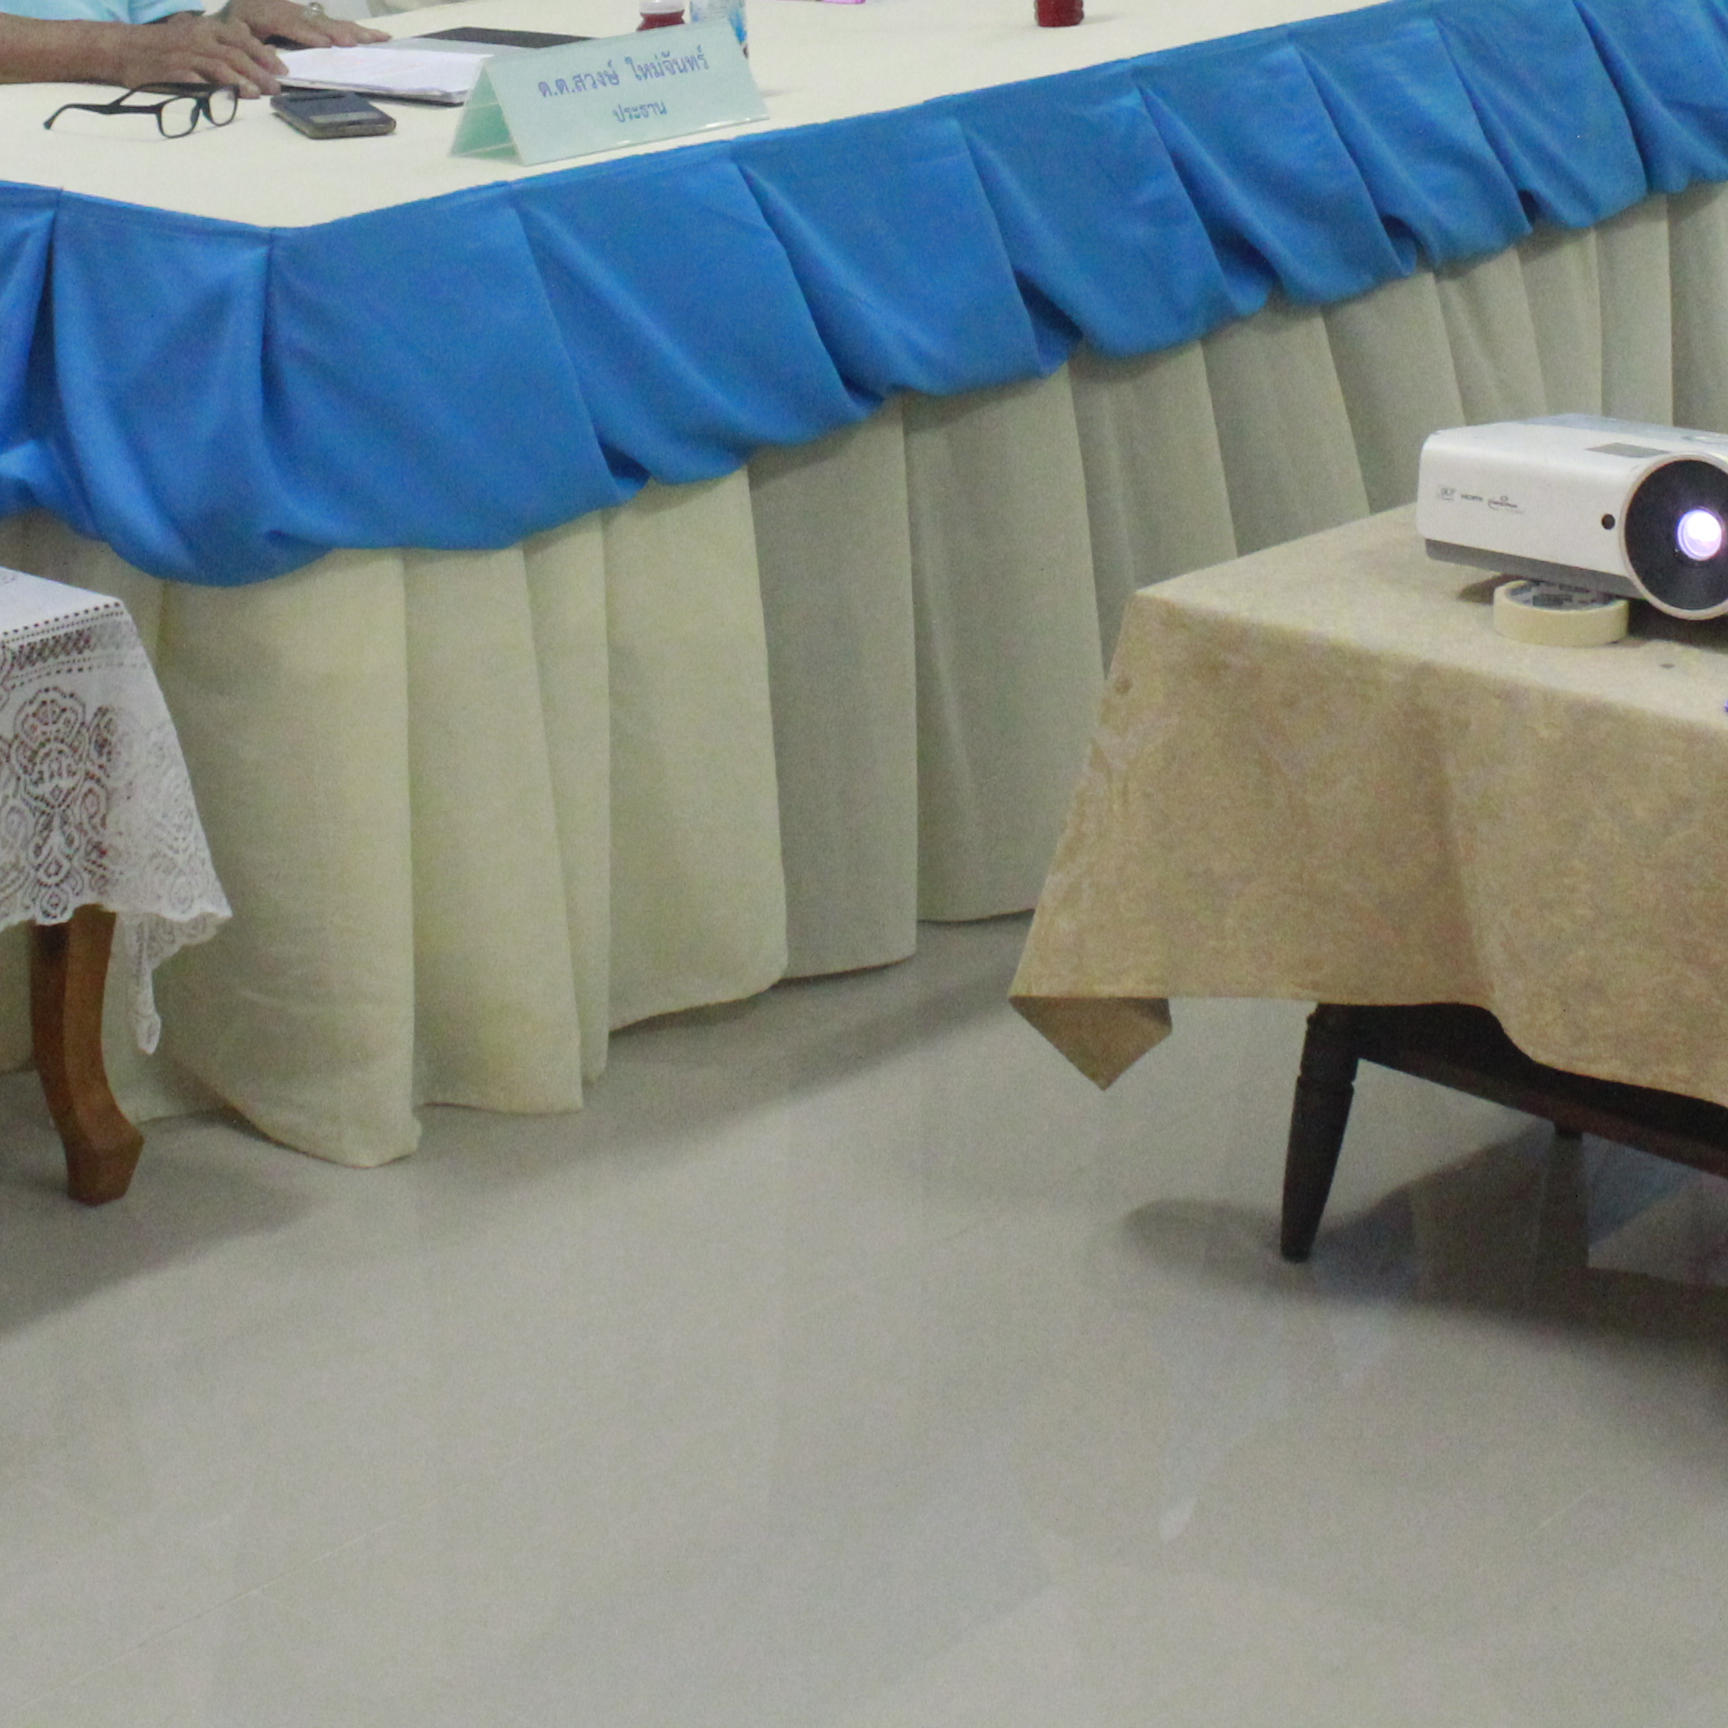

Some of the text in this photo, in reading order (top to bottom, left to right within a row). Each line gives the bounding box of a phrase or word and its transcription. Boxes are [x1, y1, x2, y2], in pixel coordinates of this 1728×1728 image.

[625, 45, 710, 83] ใหม่จันทร์
[613, 98, 668, 123] ประธาน
